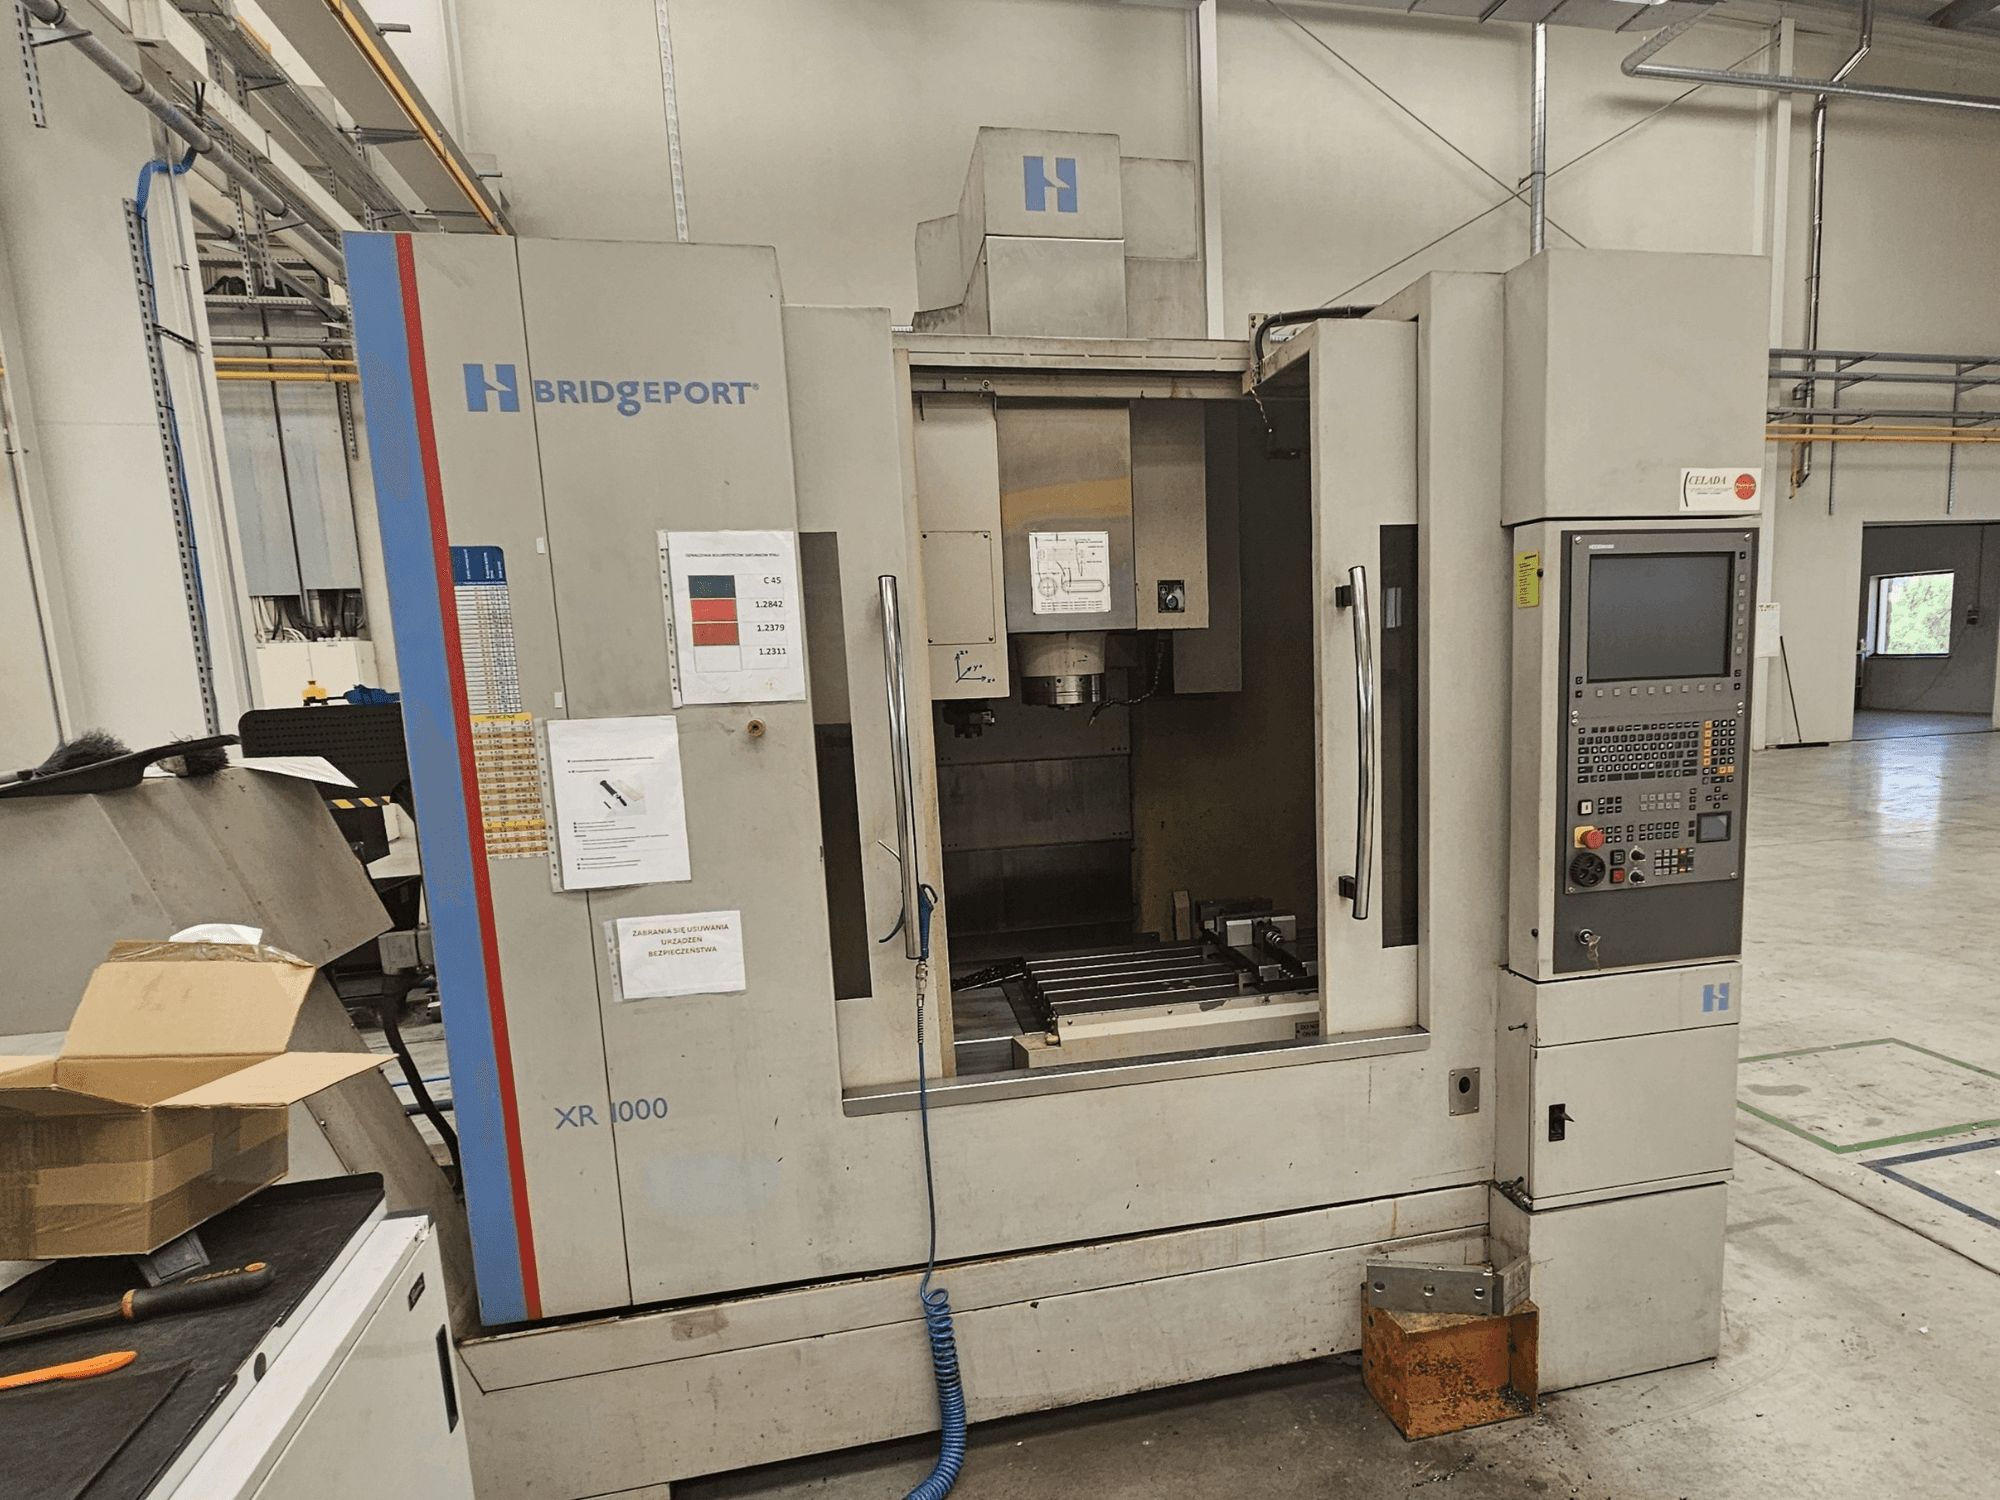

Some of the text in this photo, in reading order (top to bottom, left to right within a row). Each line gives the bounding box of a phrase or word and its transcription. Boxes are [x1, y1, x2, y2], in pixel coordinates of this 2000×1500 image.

[763, 576, 782, 584] C 45
[755, 600, 783, 608] 1.2842
[757, 623, 786, 632] 1.2379
[759, 647, 787, 656] 1.2311
[632, 924, 729, 937] ZABRANIA SIĘ USUWANIA
[648, 946, 717, 957] BEZPIECZEŃSTWA
[554, 1097, 668, 1130] XR 1000
